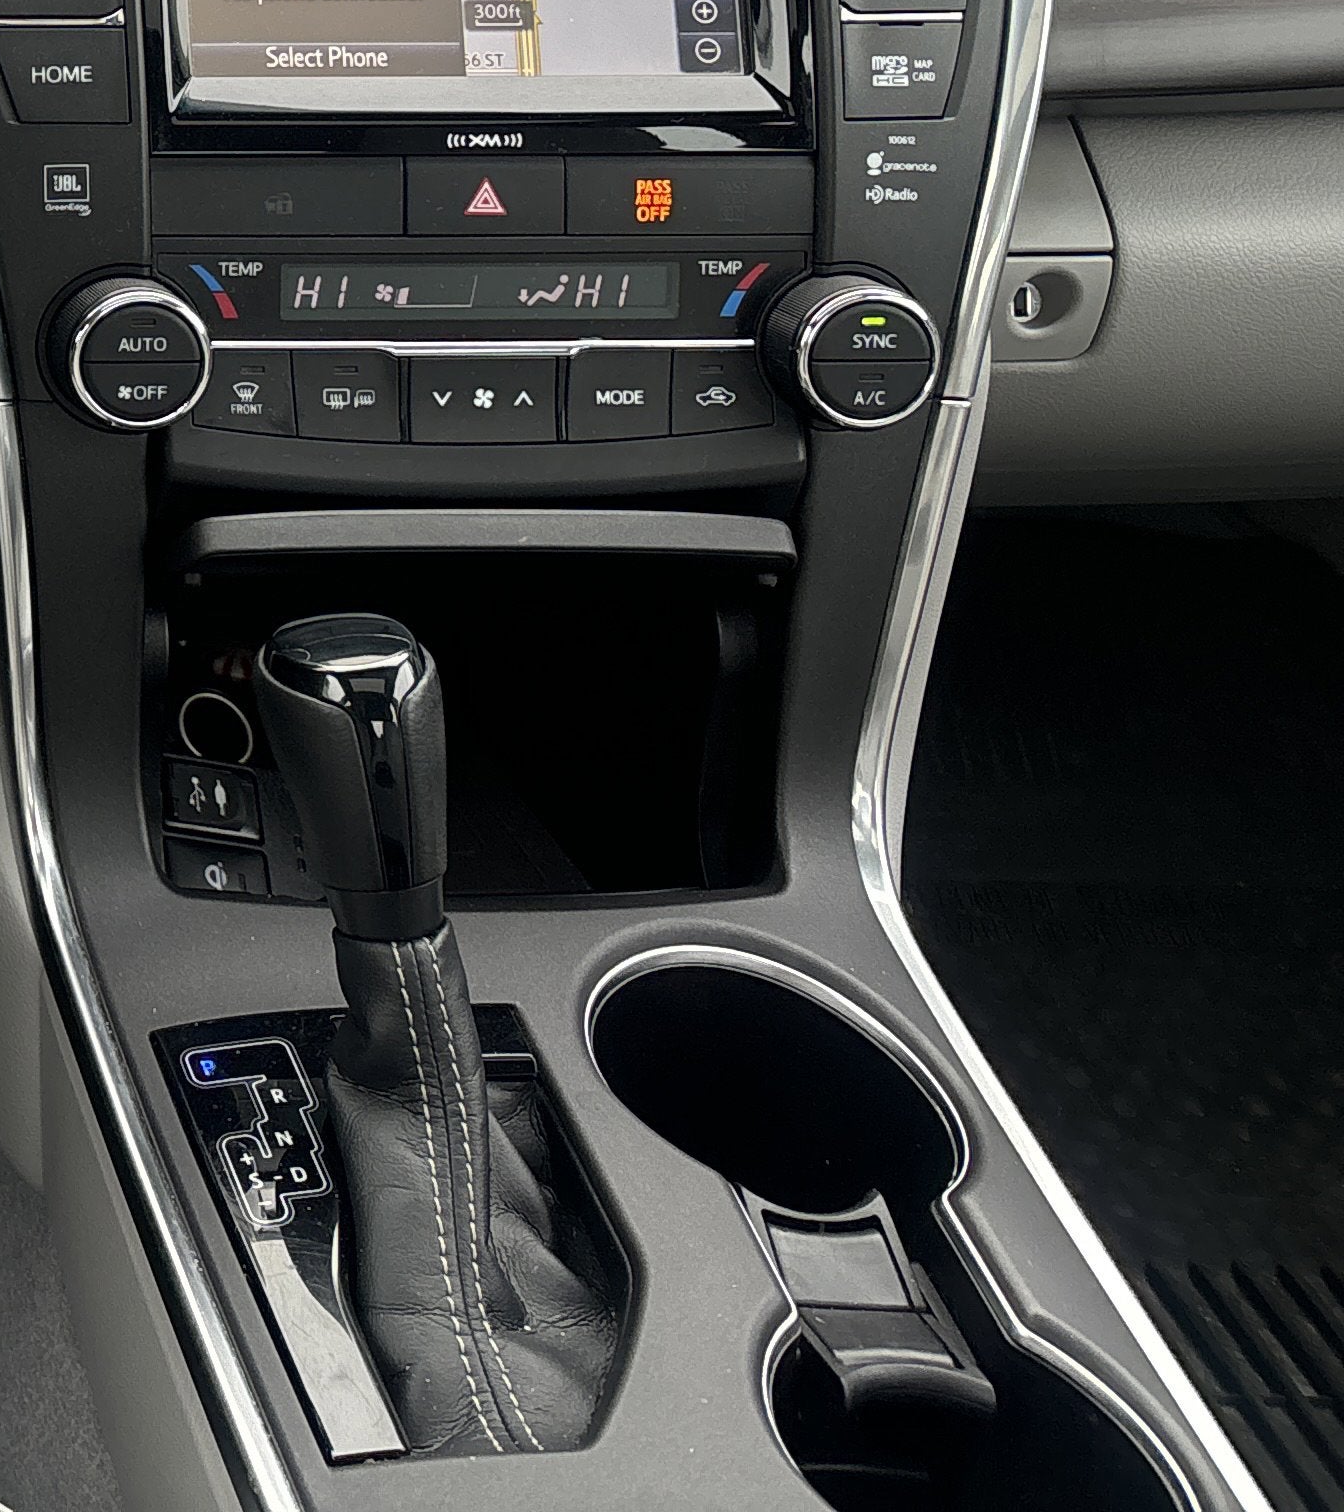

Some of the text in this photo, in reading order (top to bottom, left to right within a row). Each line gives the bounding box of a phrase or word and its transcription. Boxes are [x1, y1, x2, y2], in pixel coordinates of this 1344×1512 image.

[474, 3, 522, 20] 300ft
[265, 45, 389, 68] Select Phone
[484, 53, 505, 67] ST
[914, 60, 934, 69] MAP
[31, 65, 94, 84] HOME
[912, 72, 936, 82] CARD
[882, 162, 938, 173] gracenote
[53, 174, 82, 192] JBL
[636, 179, 672, 194] PASS
[634, 194, 673, 206] AIR BAG
[885, 188, 919, 202] Radio
[636, 206, 671, 222] OFF
[218, 261, 263, 277] TEMP
[698, 259, 743, 276] TEMP
[293, 275, 348, 309] HI
[574, 274, 630, 309] HI
[118, 337, 167, 353] AUTO
[852, 333, 897, 350] SYNC
[133, 385, 168, 401] OFF
[596, 390, 645, 406] MODE
[853, 390, 887, 407] A/C
[230, 403, 263, 415] FRONT
[199, 1059, 216, 1077] P
[269, 1088, 289, 1104] R
[274, 1130, 294, 1147] N
[248, 1166, 308, 1189] S D
